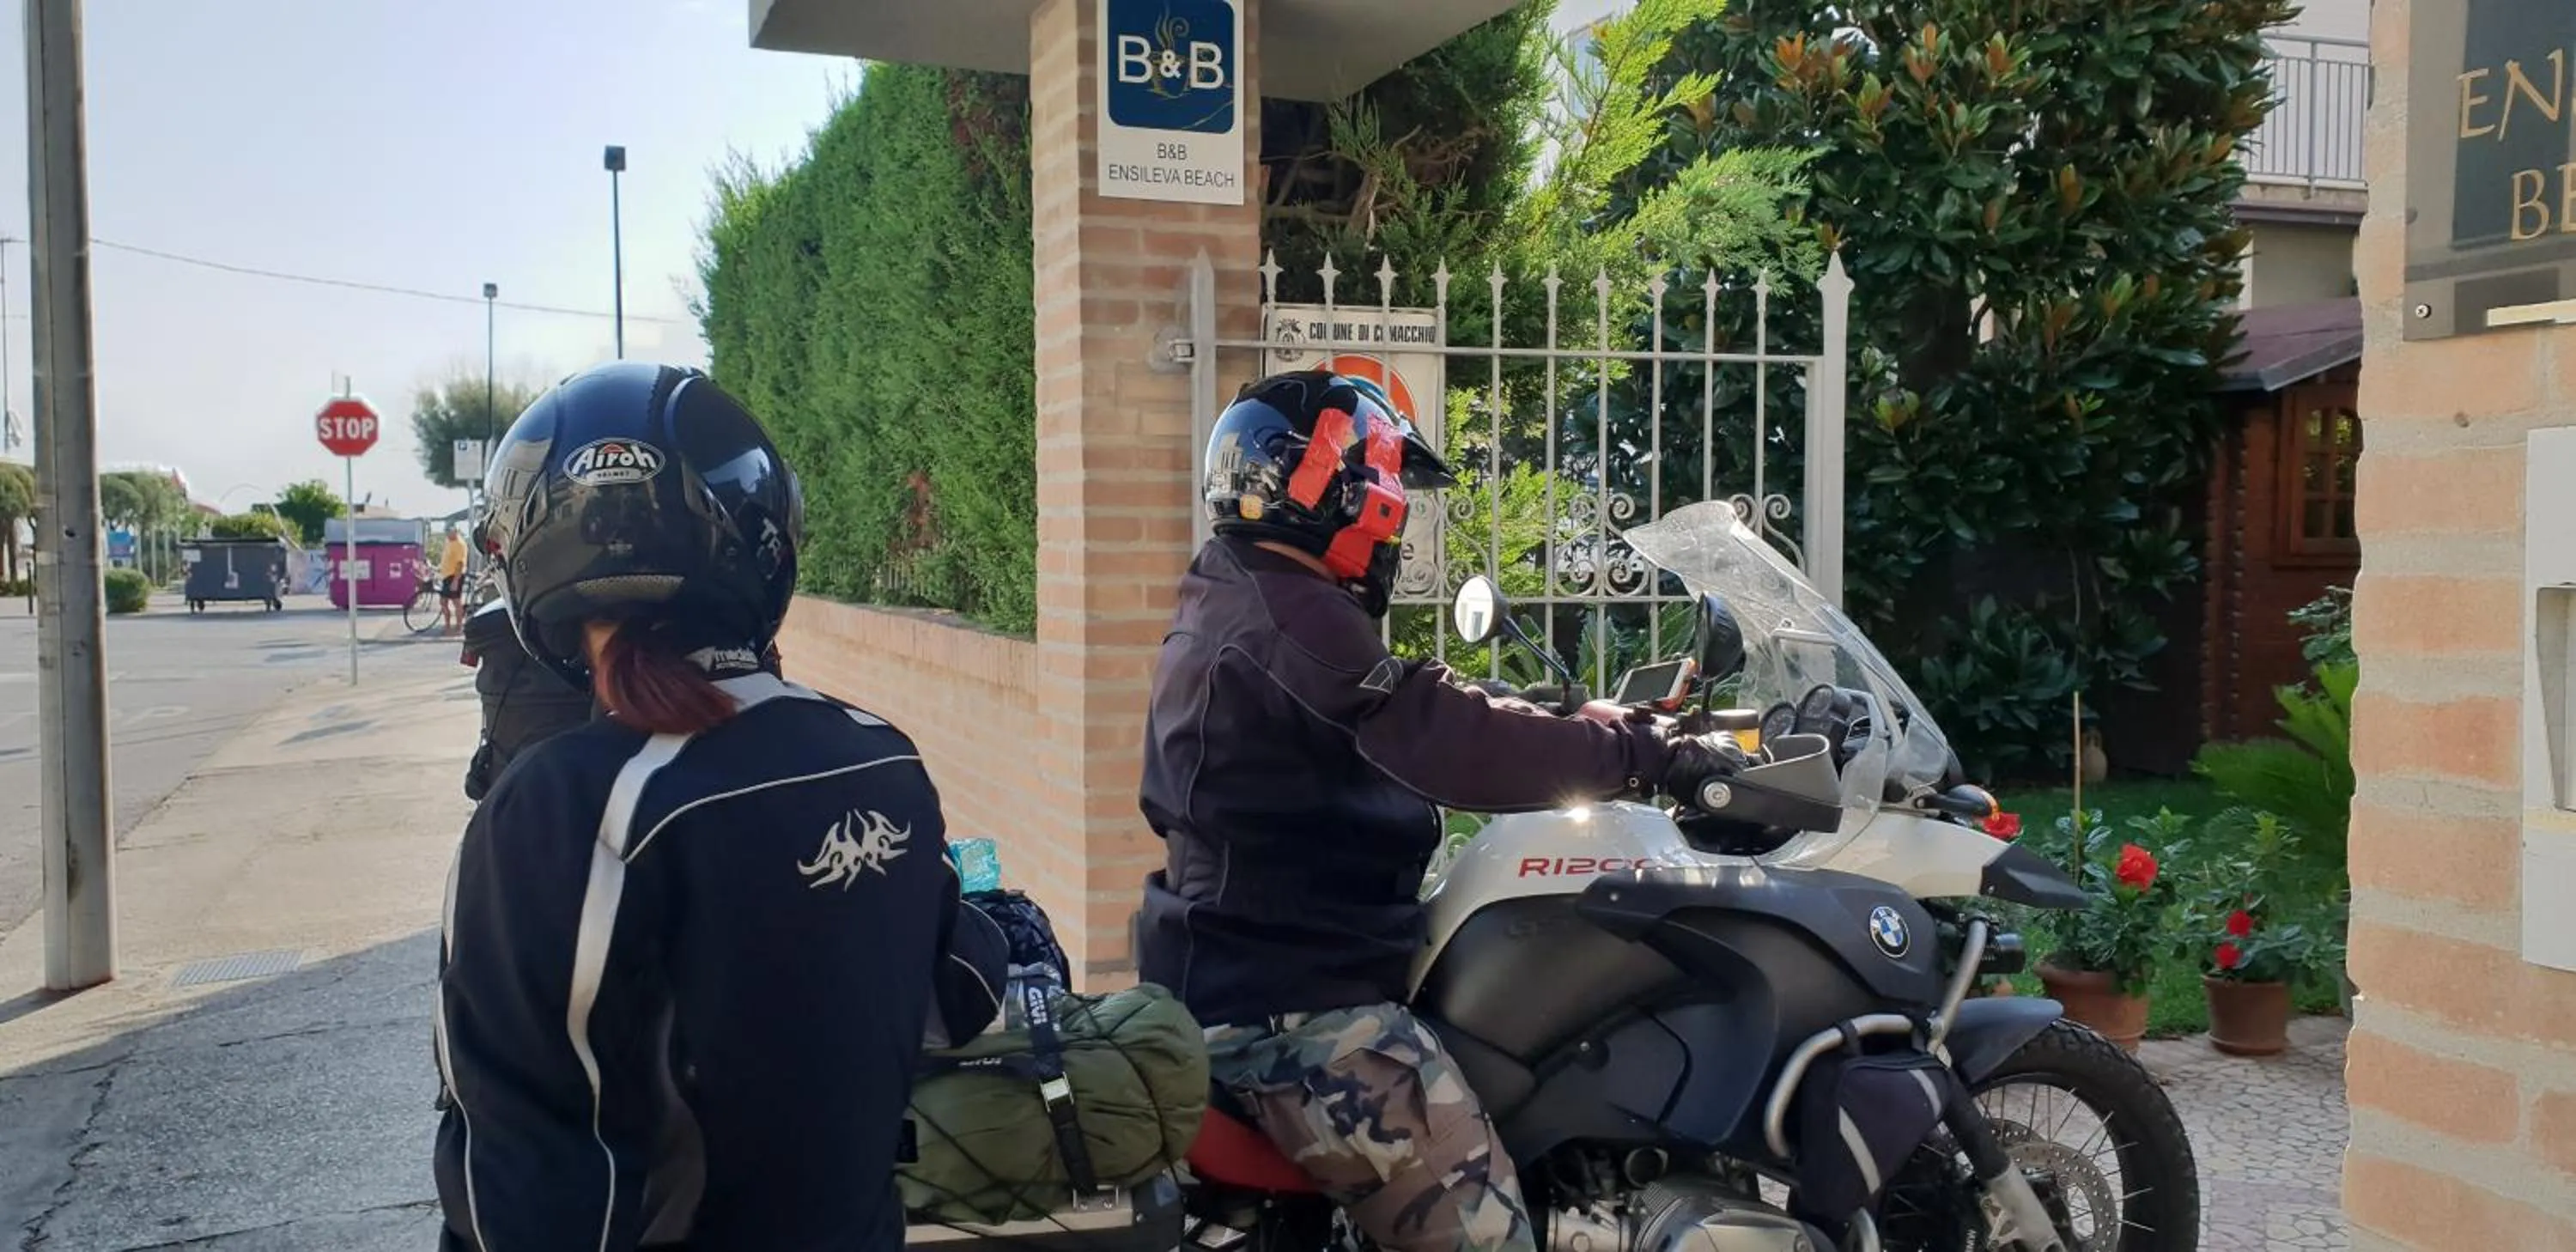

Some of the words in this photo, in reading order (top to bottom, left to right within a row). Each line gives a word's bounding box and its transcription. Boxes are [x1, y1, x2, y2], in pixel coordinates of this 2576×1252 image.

[1118, 34, 1224, 88] B&B
[2457, 48, 2576, 141] EN
[1157, 143, 1188, 161] B&B
[1108, 164, 1181, 184] ENSILEVA
[1184, 169, 1235, 188] BEACH
[1358, 324, 1369, 341] DI
[319, 416, 375, 441] STOP
[571, 443, 657, 474] Airoh
[1029, 987, 1048, 1024] GIVI
